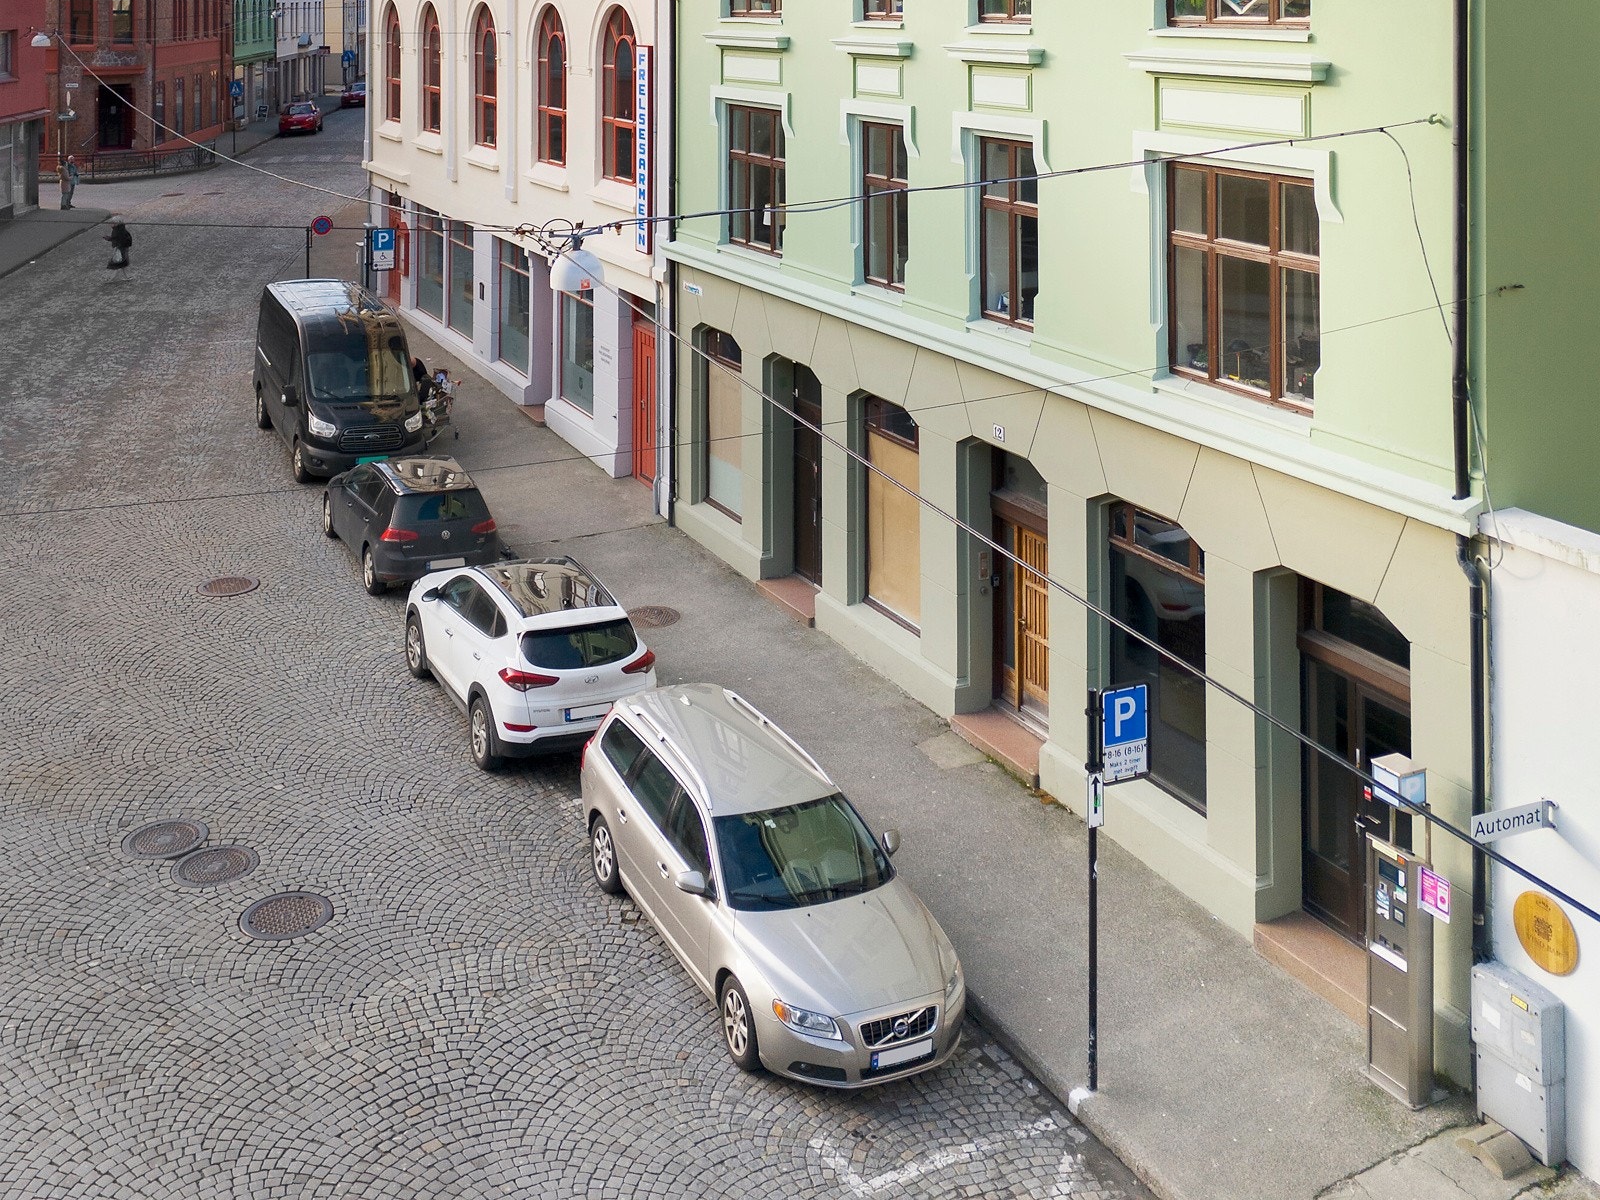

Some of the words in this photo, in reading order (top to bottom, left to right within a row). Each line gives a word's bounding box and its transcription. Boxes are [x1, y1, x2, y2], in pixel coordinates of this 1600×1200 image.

[638, 53, 646, 246] FRELSESARMEEN
[378, 232, 389, 248] P
[994, 426, 1002, 439] 12
[1114, 696, 1136, 737] P
[1474, 808, 1541, 838] Automat
